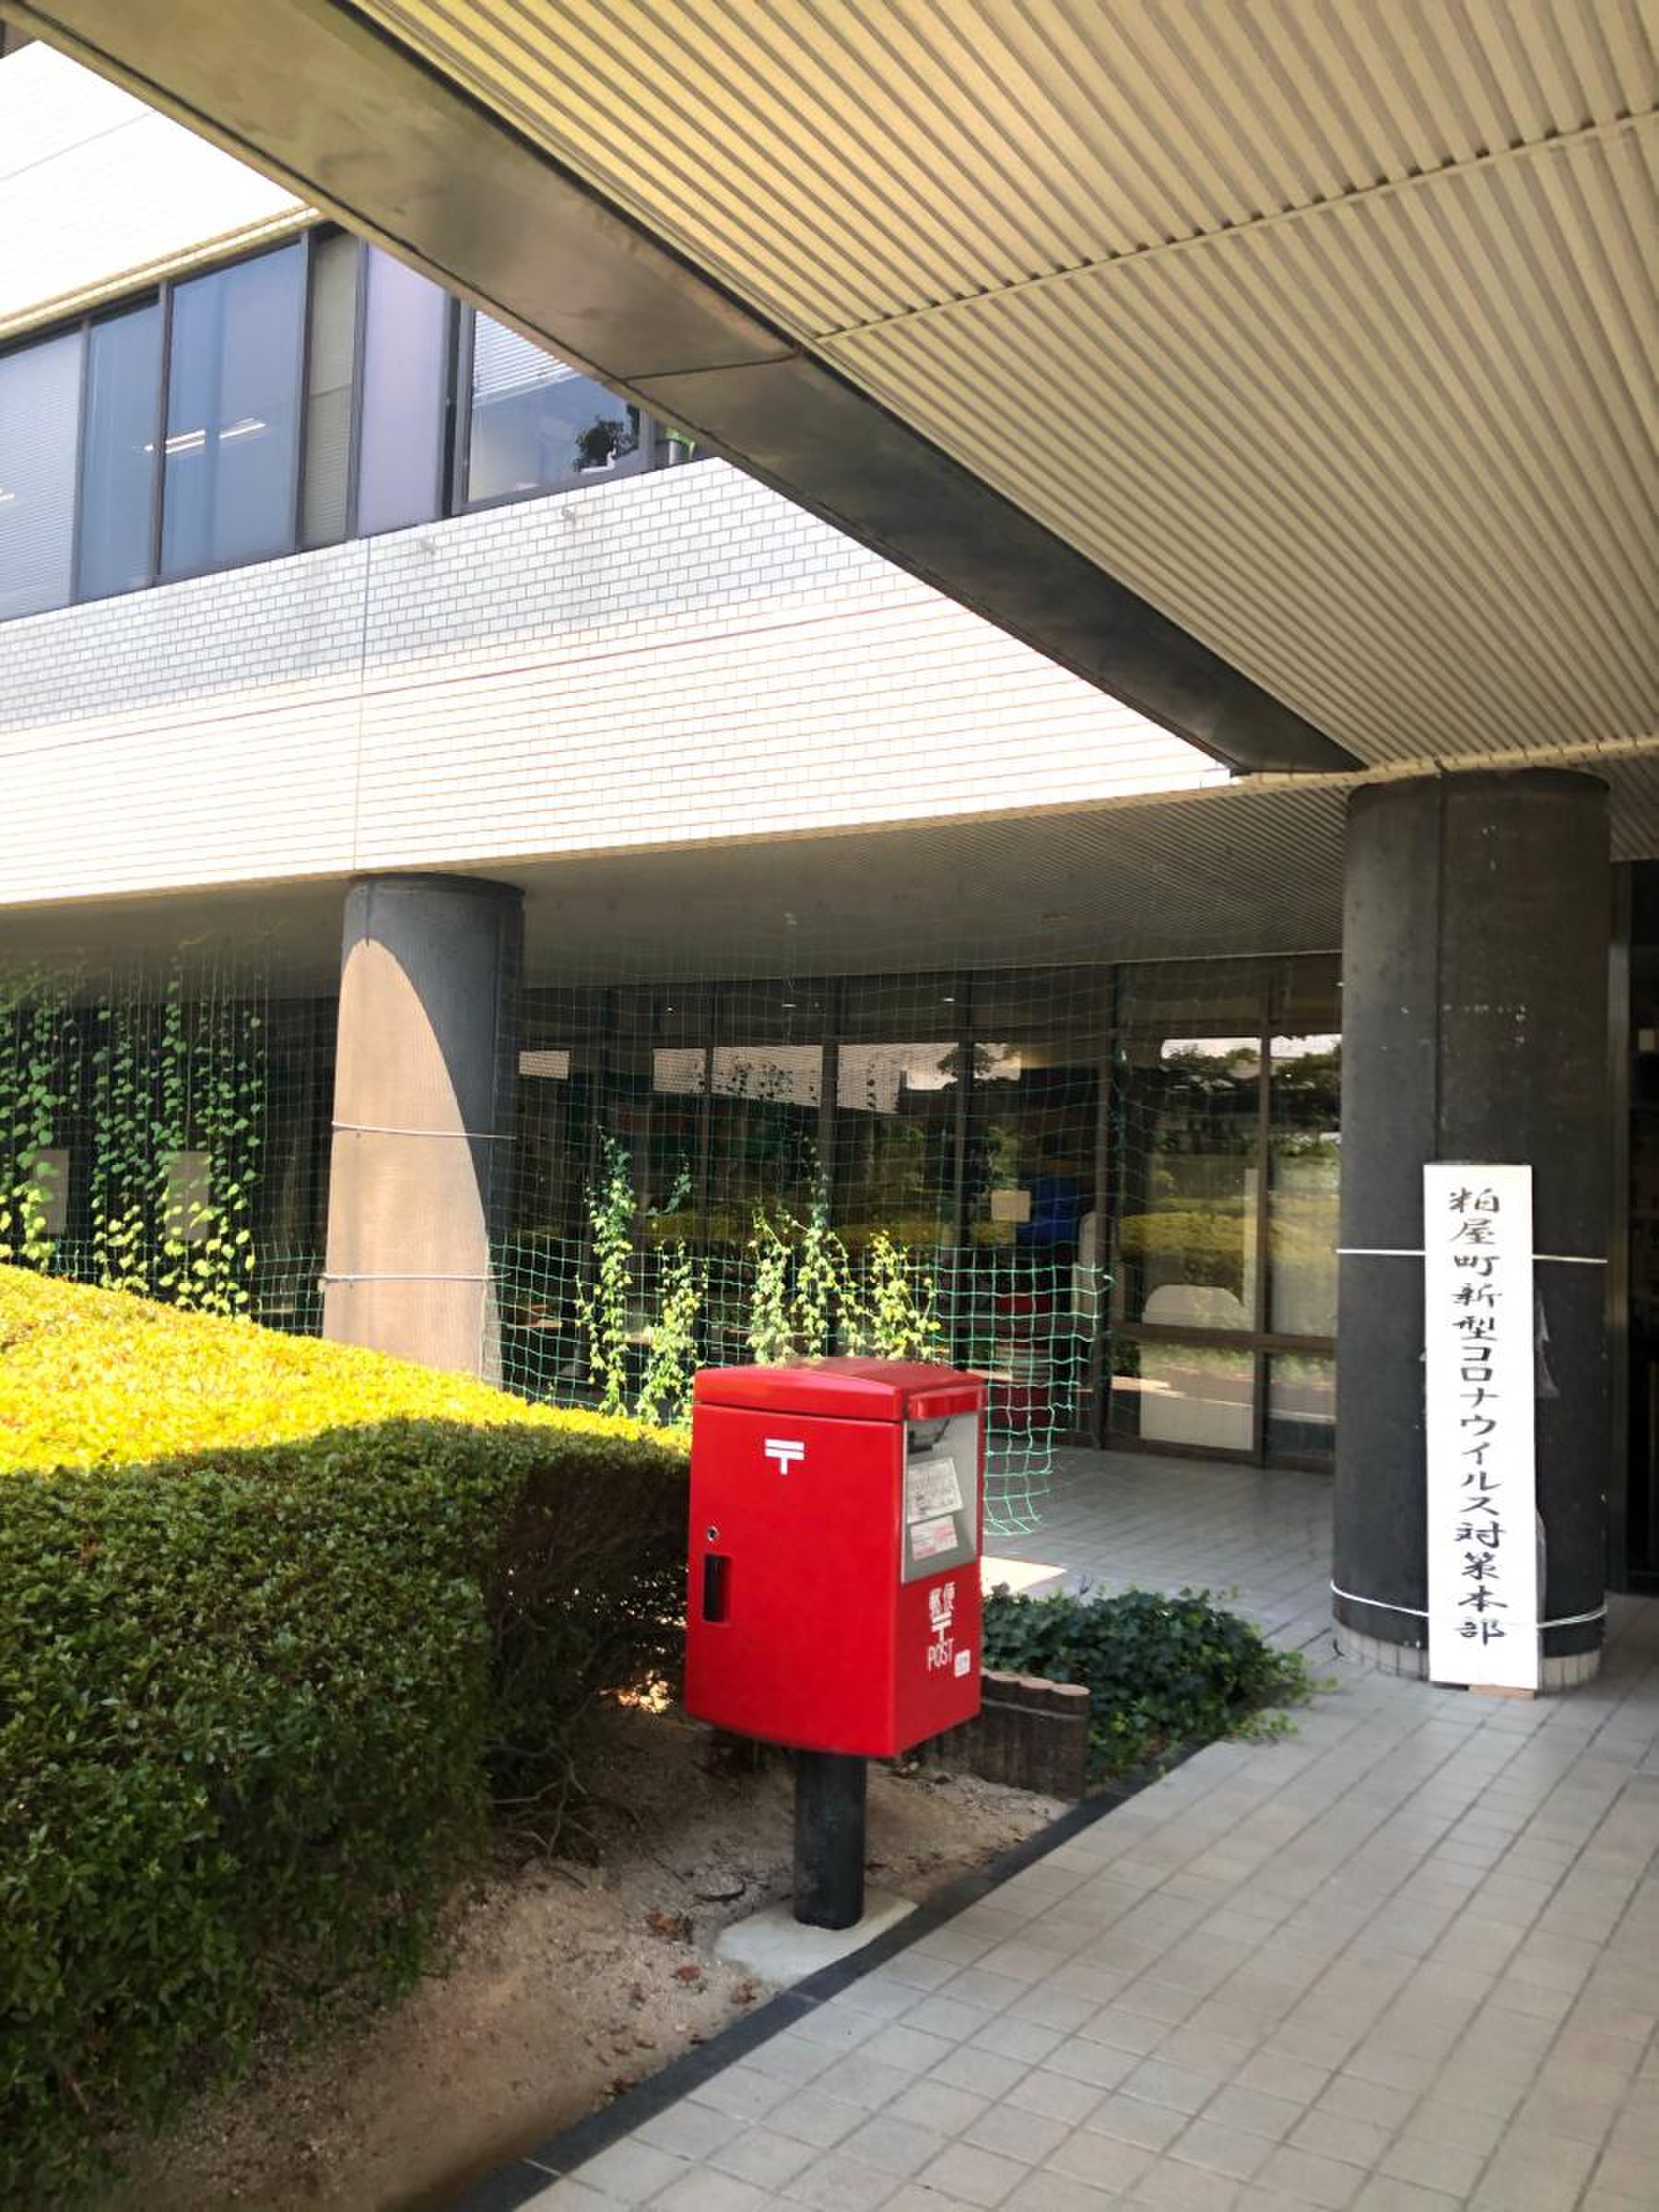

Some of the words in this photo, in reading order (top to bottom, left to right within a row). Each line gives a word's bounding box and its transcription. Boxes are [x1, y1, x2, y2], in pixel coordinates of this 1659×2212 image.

[1448, 1188, 1508, 1646] 粕屋町新型コロナウイルス対策本部
[927, 1638, 955, 1671] POST
